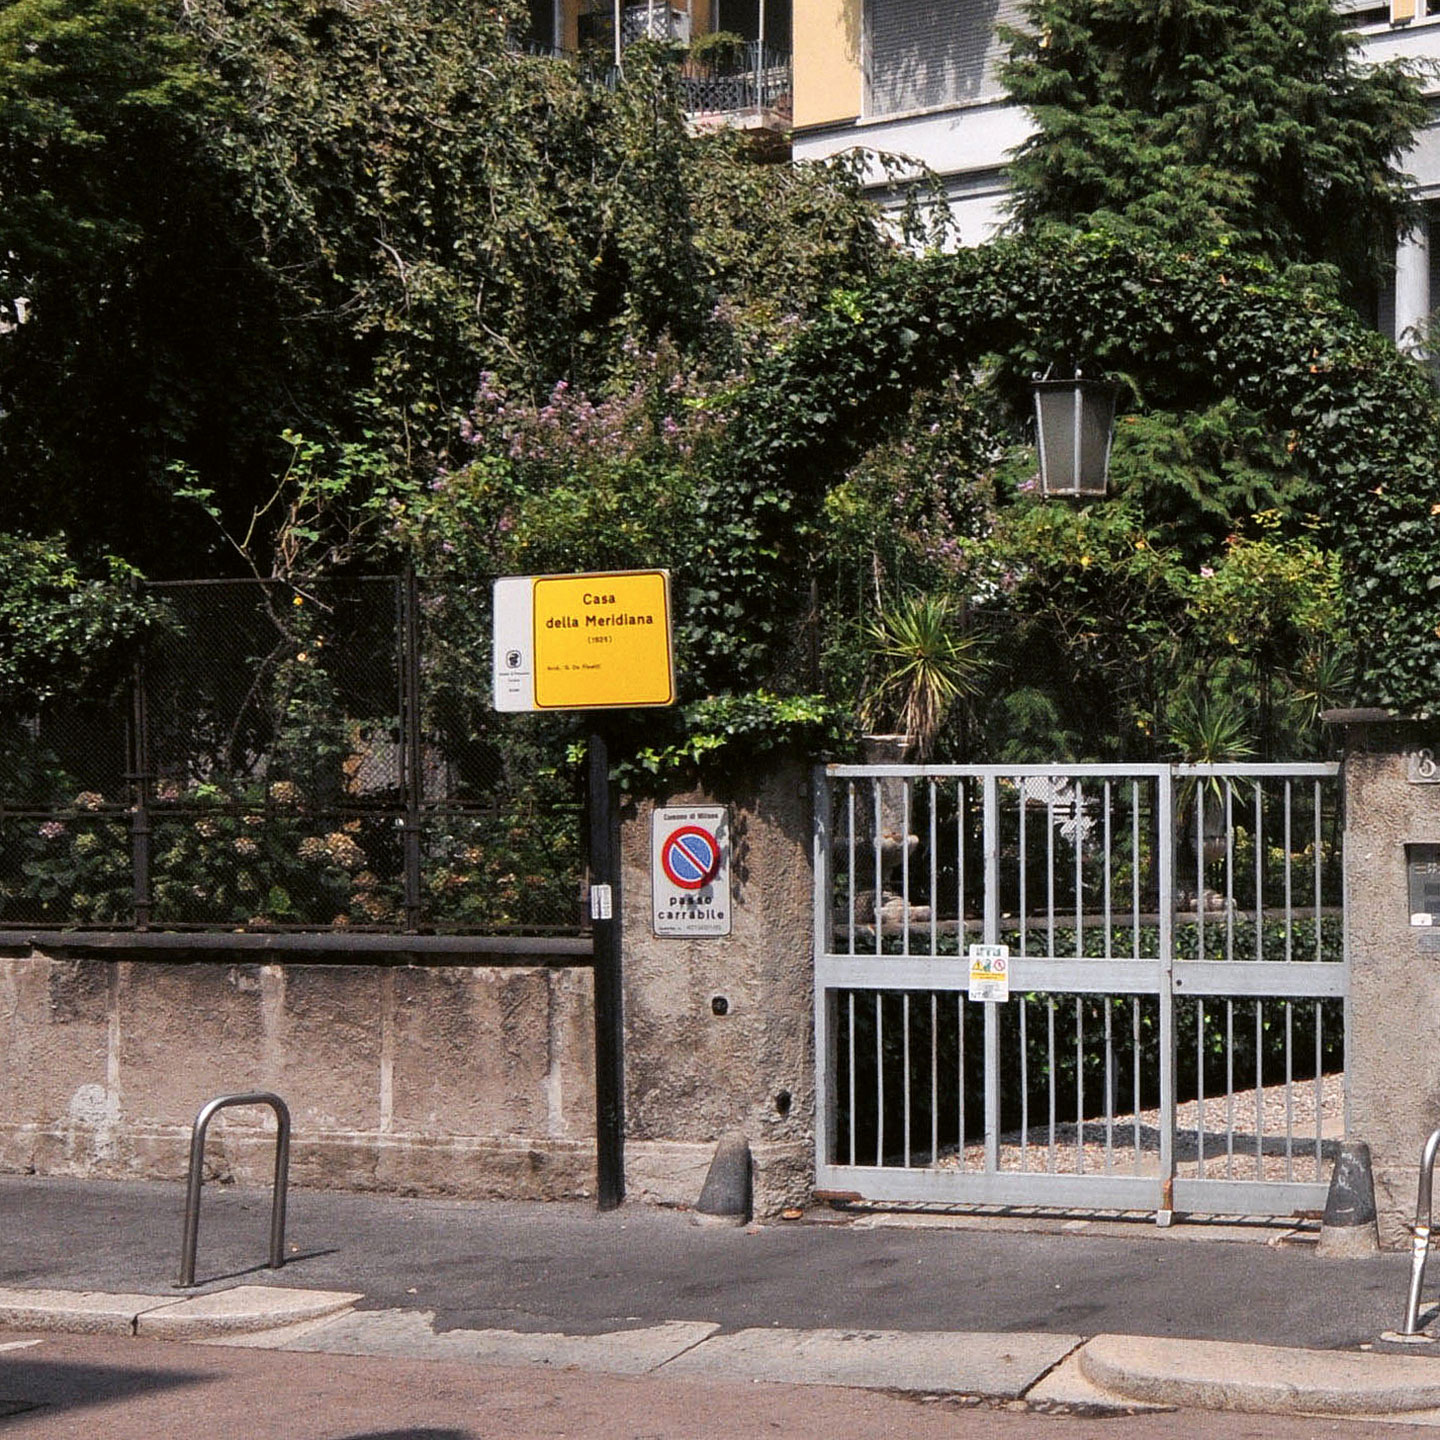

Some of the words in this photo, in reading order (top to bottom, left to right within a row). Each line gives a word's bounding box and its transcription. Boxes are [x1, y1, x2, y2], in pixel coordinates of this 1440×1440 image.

[583, 593, 616, 605] Casa
[545, 616, 579, 628] della
[585, 613, 653, 627] Meridiana
[1418, 748, 1437, 778] 3
[689, 812, 696, 820] di
[669, 895, 713, 907] passo
[657, 908, 724, 920] carrabile
